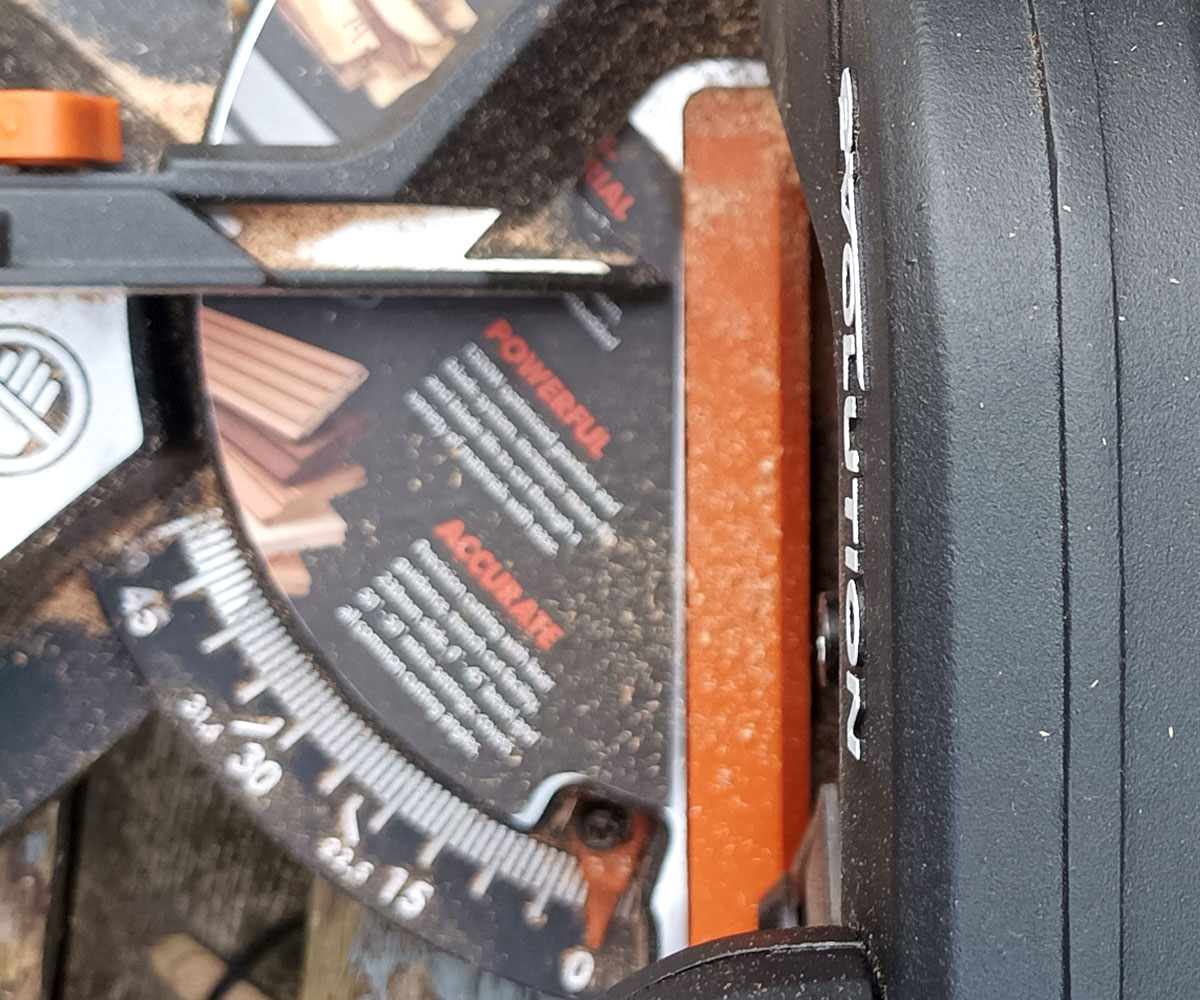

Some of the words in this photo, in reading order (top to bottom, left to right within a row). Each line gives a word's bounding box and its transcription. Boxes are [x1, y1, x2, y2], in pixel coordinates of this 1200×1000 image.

[484, 318, 610, 459] POWERFUL
[434, 518, 563, 650] ACCURATE
[225, 742, 283, 797] 30
[379, 865, 435, 920] 15
